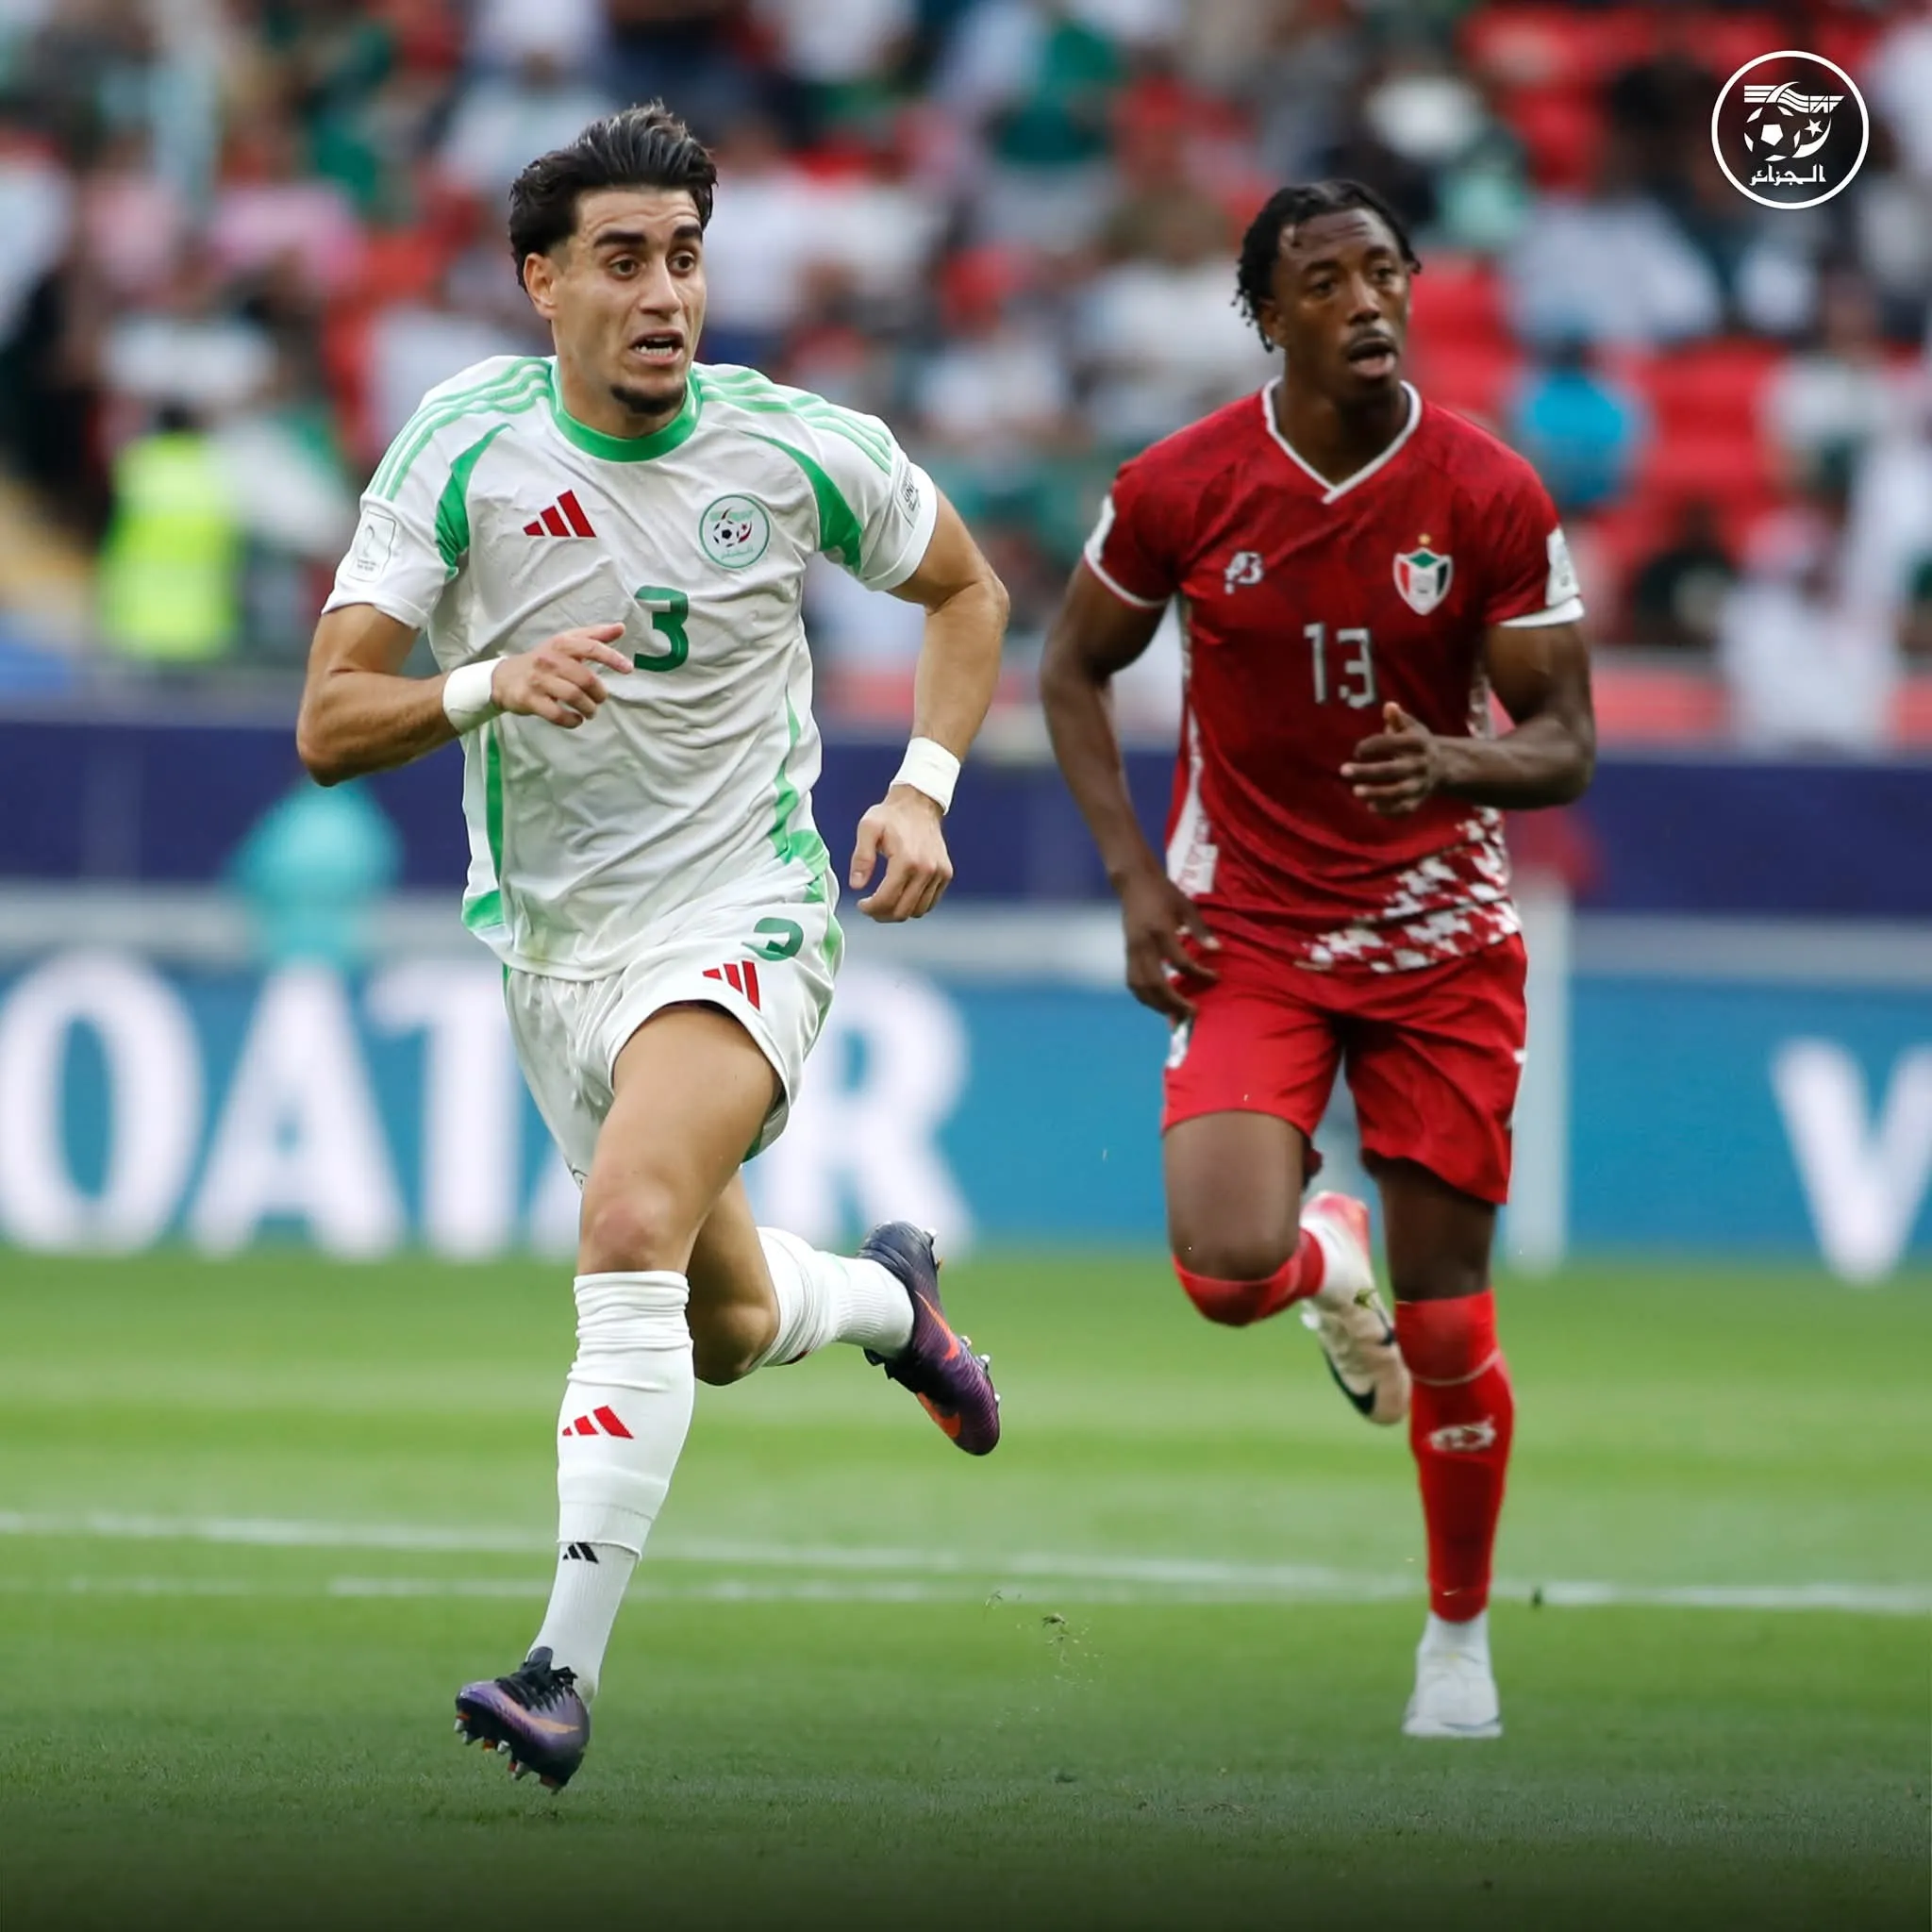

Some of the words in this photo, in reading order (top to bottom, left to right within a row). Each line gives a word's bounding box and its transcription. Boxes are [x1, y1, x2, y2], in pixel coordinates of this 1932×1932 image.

[633, 585, 689, 672] 3
[1304, 623, 1377, 708] 13
[0, 951, 967, 1262] QATR
